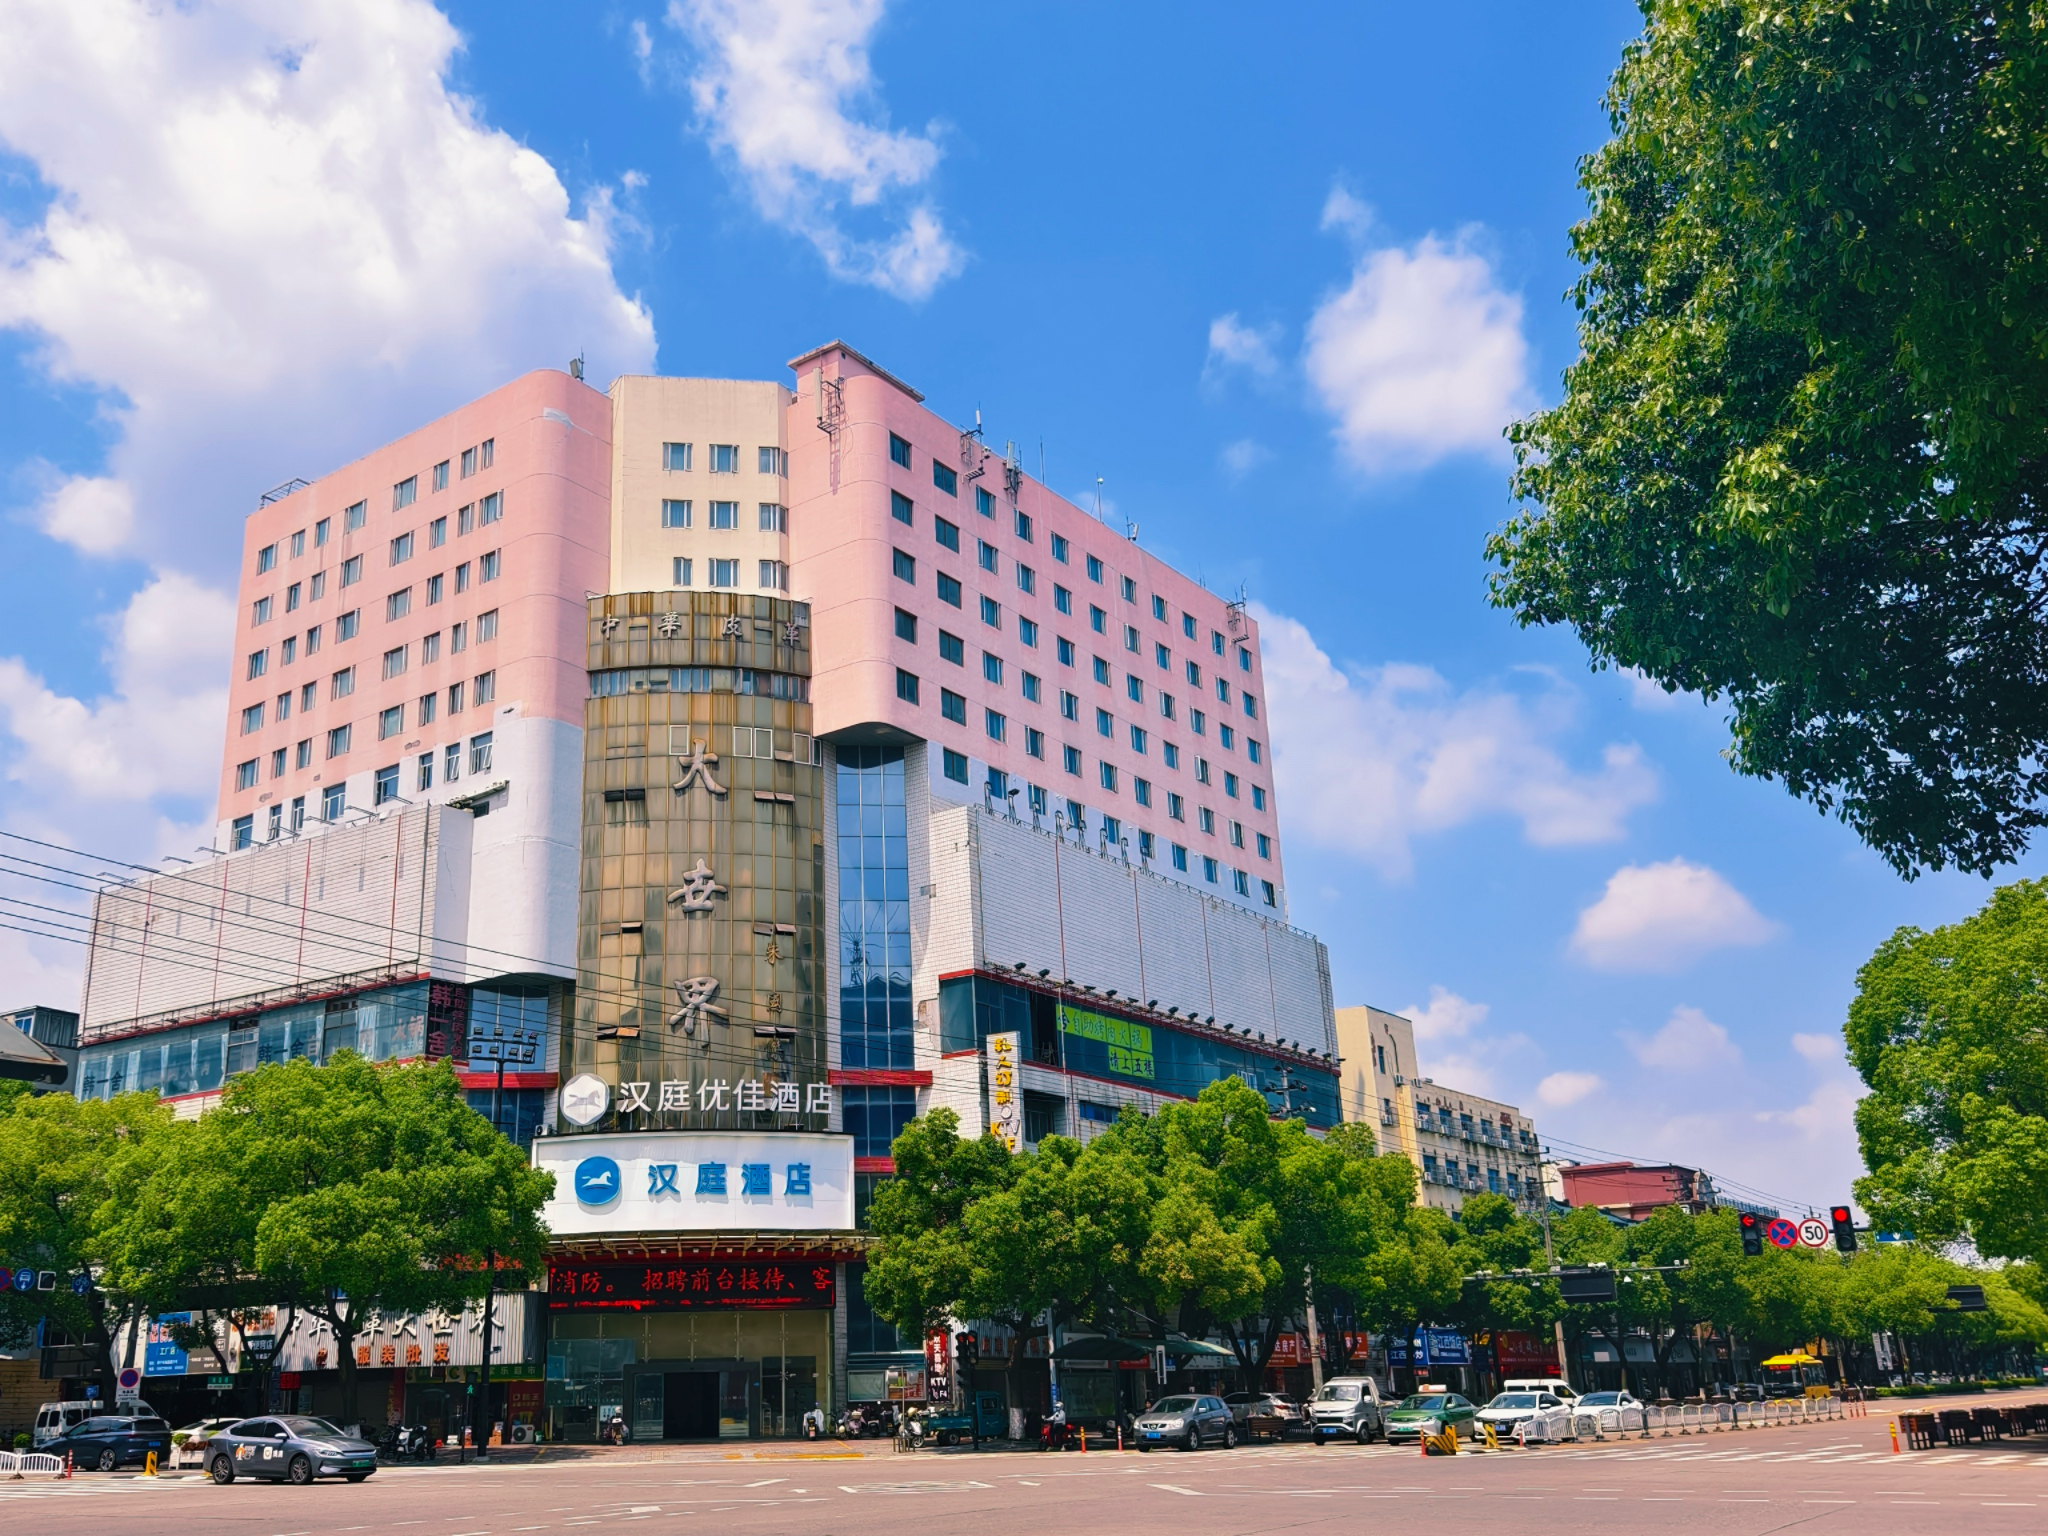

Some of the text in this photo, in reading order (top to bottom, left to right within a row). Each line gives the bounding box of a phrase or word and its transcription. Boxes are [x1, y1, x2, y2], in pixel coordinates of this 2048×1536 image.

[600, 610, 801, 648] 中華皮革
[666, 737, 730, 1050] 大世界
[429, 984, 451, 1054] 韩一舍
[619, 1078, 834, 1115] 汉庭优佳酒店
[647, 1162, 813, 1196] 汉庭酒店
[1804, 1225, 1824, 1241] 50
[550, 1267, 834, 1294] 消防。 招聘前台接待、客
[289, 1300, 504, 1346] 中华革大世界
[1390, 1349, 1424, 1360] 江西炒
[930, 1377, 947, 1387] KTV
